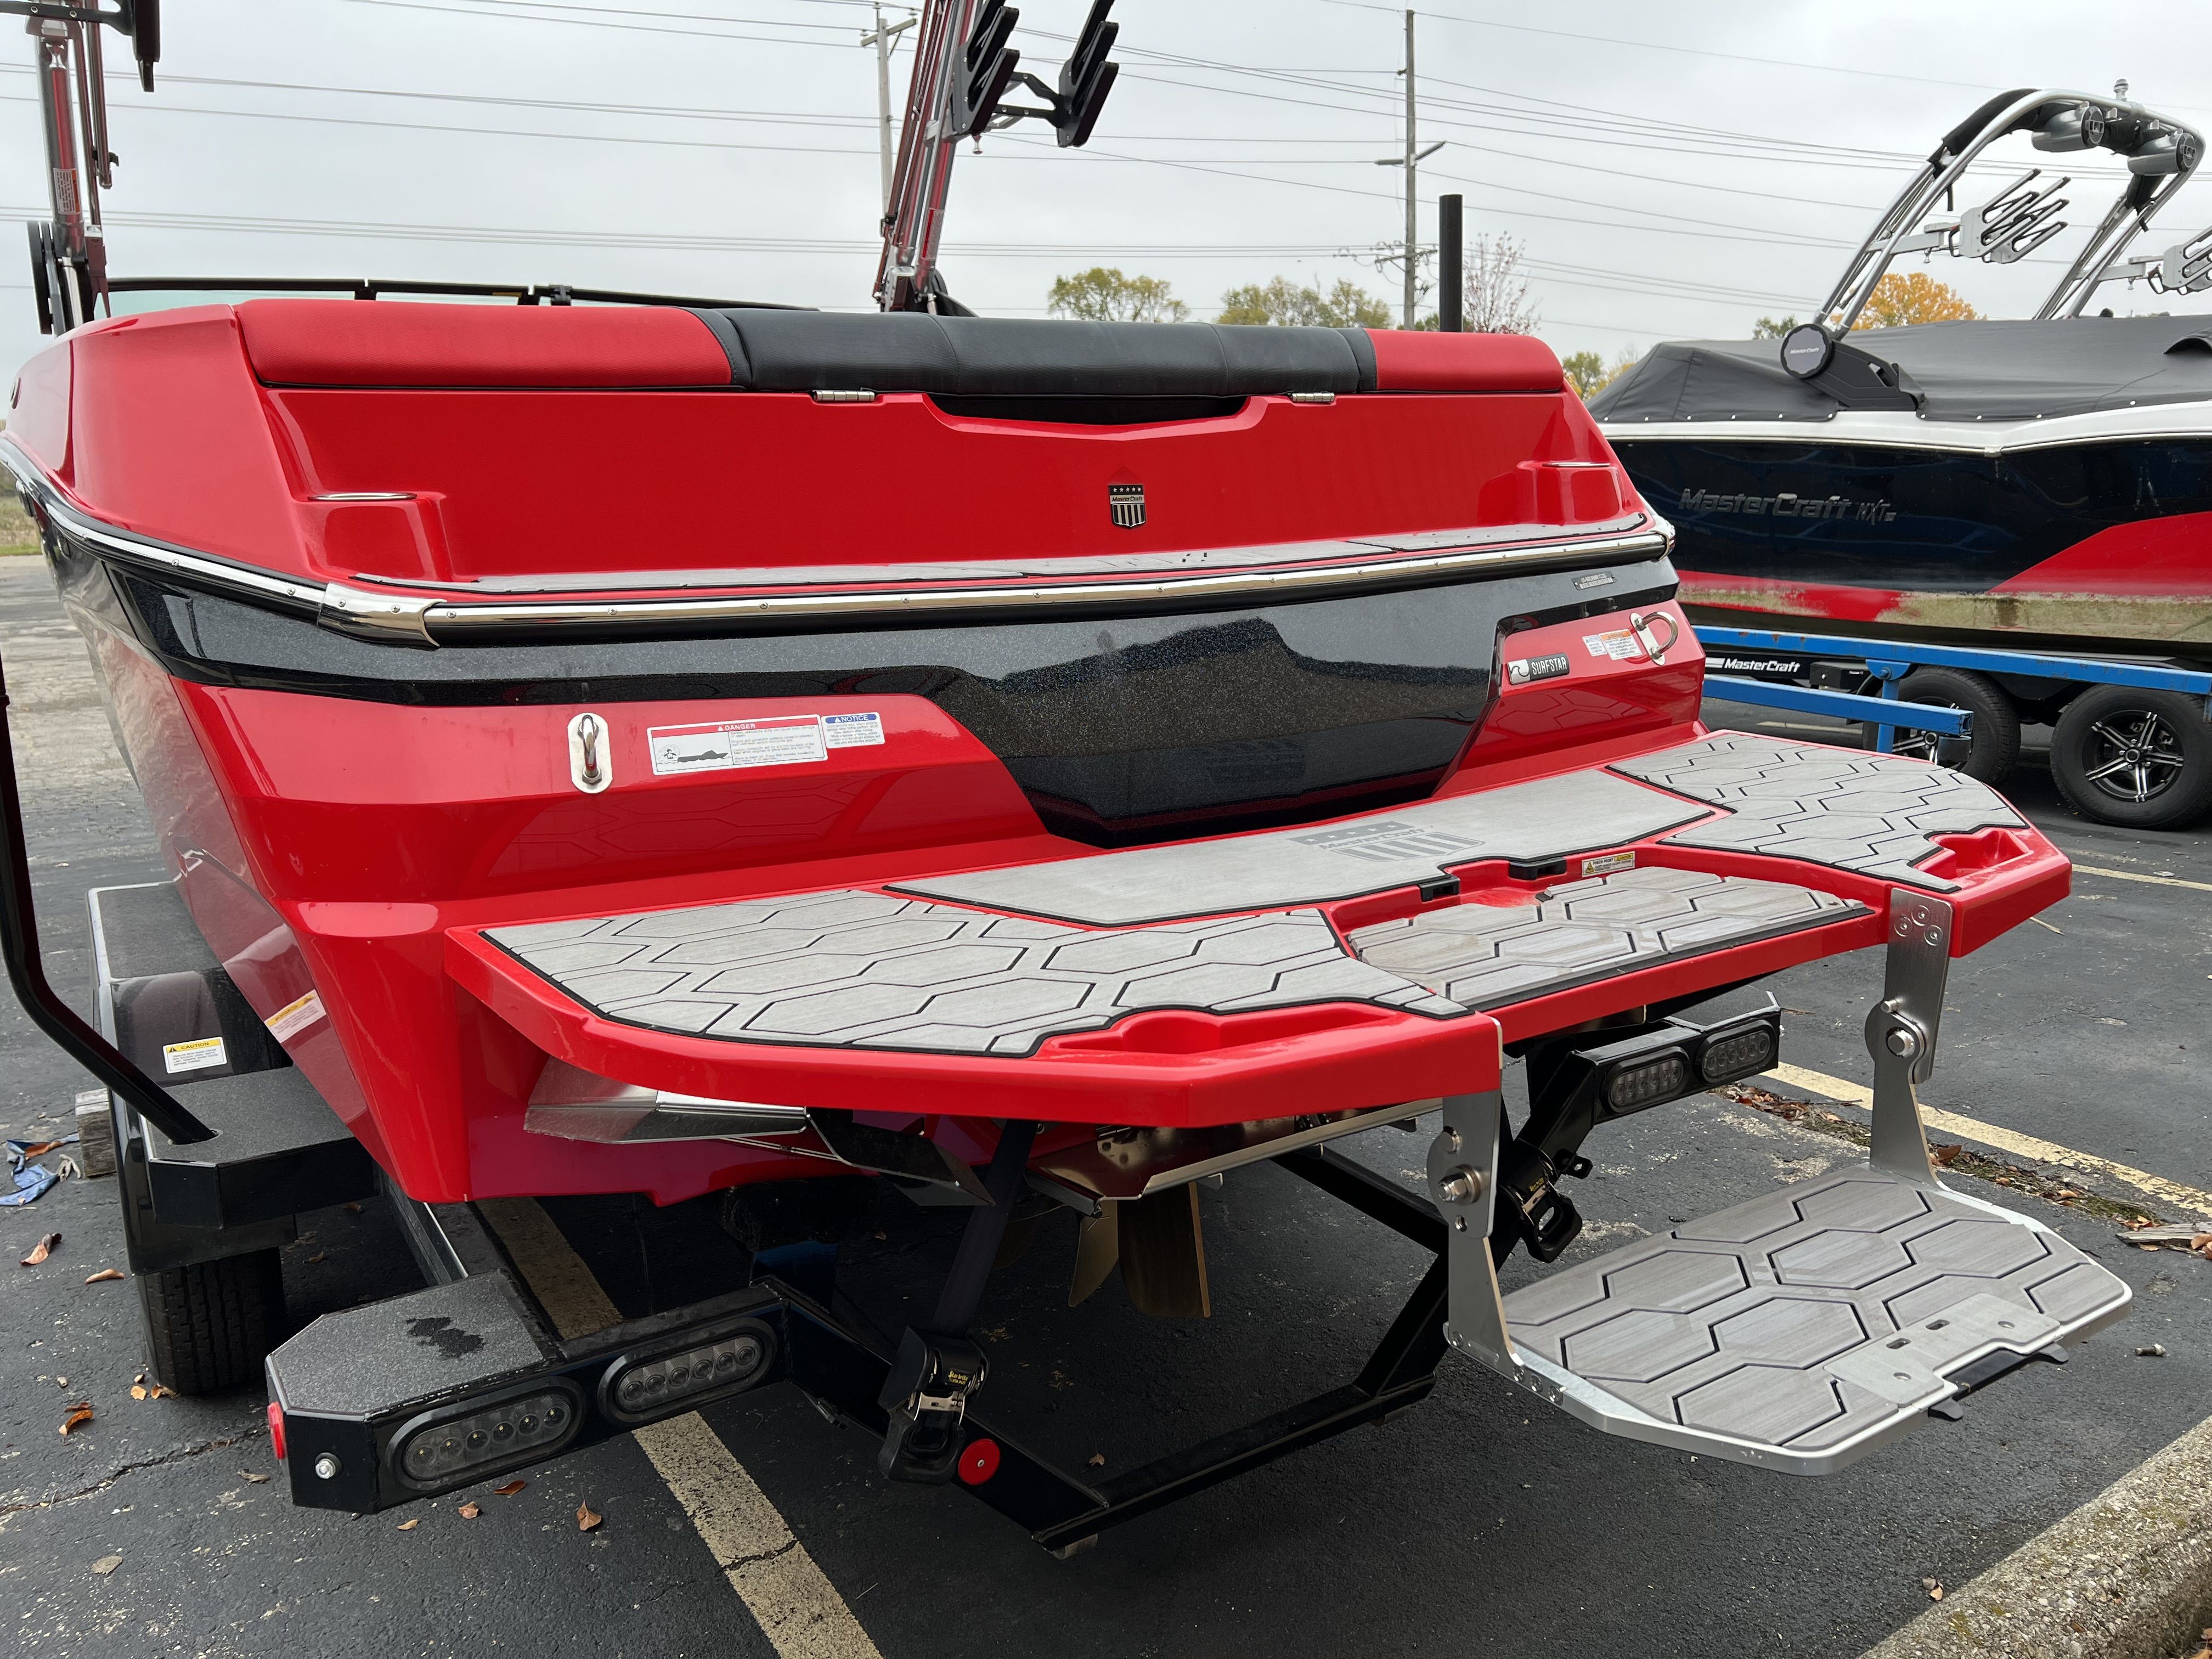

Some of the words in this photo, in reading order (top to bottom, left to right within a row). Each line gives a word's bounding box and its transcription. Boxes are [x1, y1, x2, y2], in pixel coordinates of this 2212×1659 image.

[1678, 488, 1852, 520] MasterCraft
[1531, 657, 1567, 675] SURFSTAR
[1724, 658, 1800, 673] MasterCraft
[841, 714, 868, 723] NOTICE
[1319, 828, 1425, 849] MasterCraft
[180, 1042, 209, 1050] CAUTION
